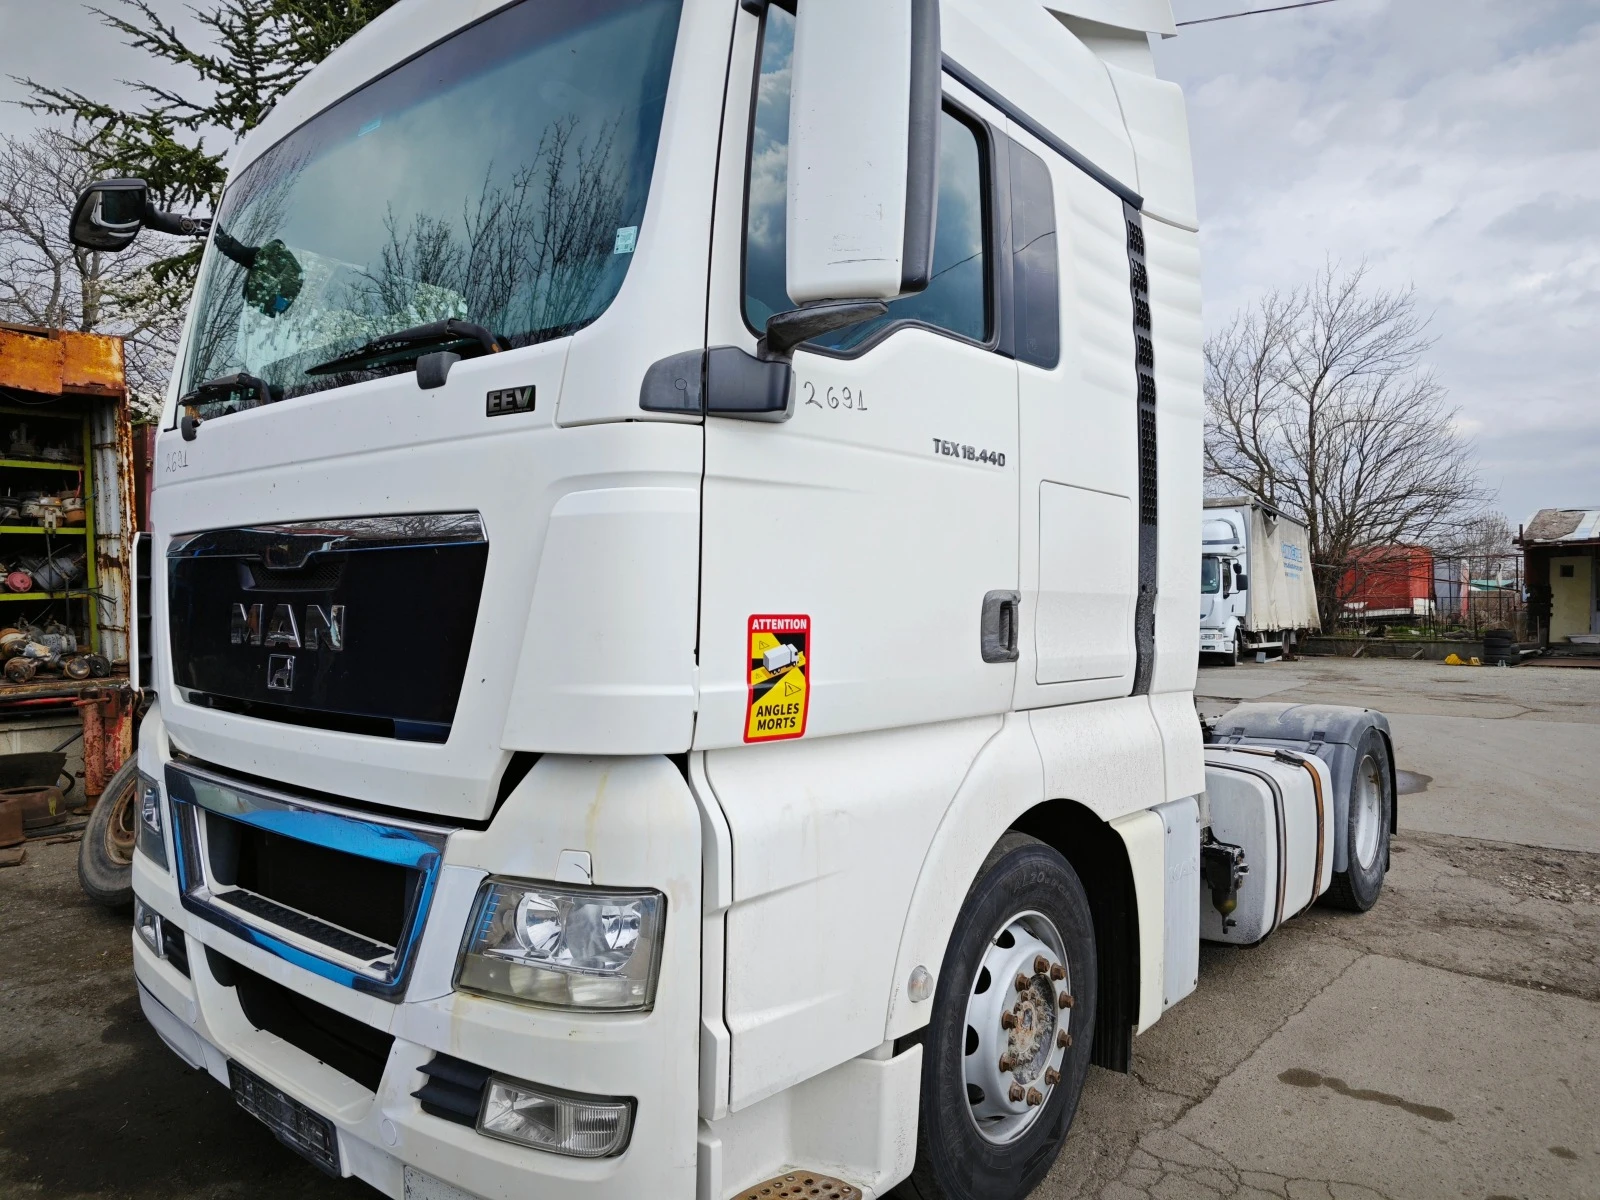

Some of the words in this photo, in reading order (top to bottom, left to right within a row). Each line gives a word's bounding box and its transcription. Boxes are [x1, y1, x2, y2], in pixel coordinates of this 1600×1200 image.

[488, 386, 533, 412] EEV
[803, 381, 868, 411] 2691
[932, 437, 960, 458] TGX
[961, 444, 1006, 467] 18.440
[231, 603, 345, 651] MAN
[752, 618, 807, 630] ATTENTION
[756, 703, 800, 718] ANGLES
[757, 716, 796, 731] MORTS
